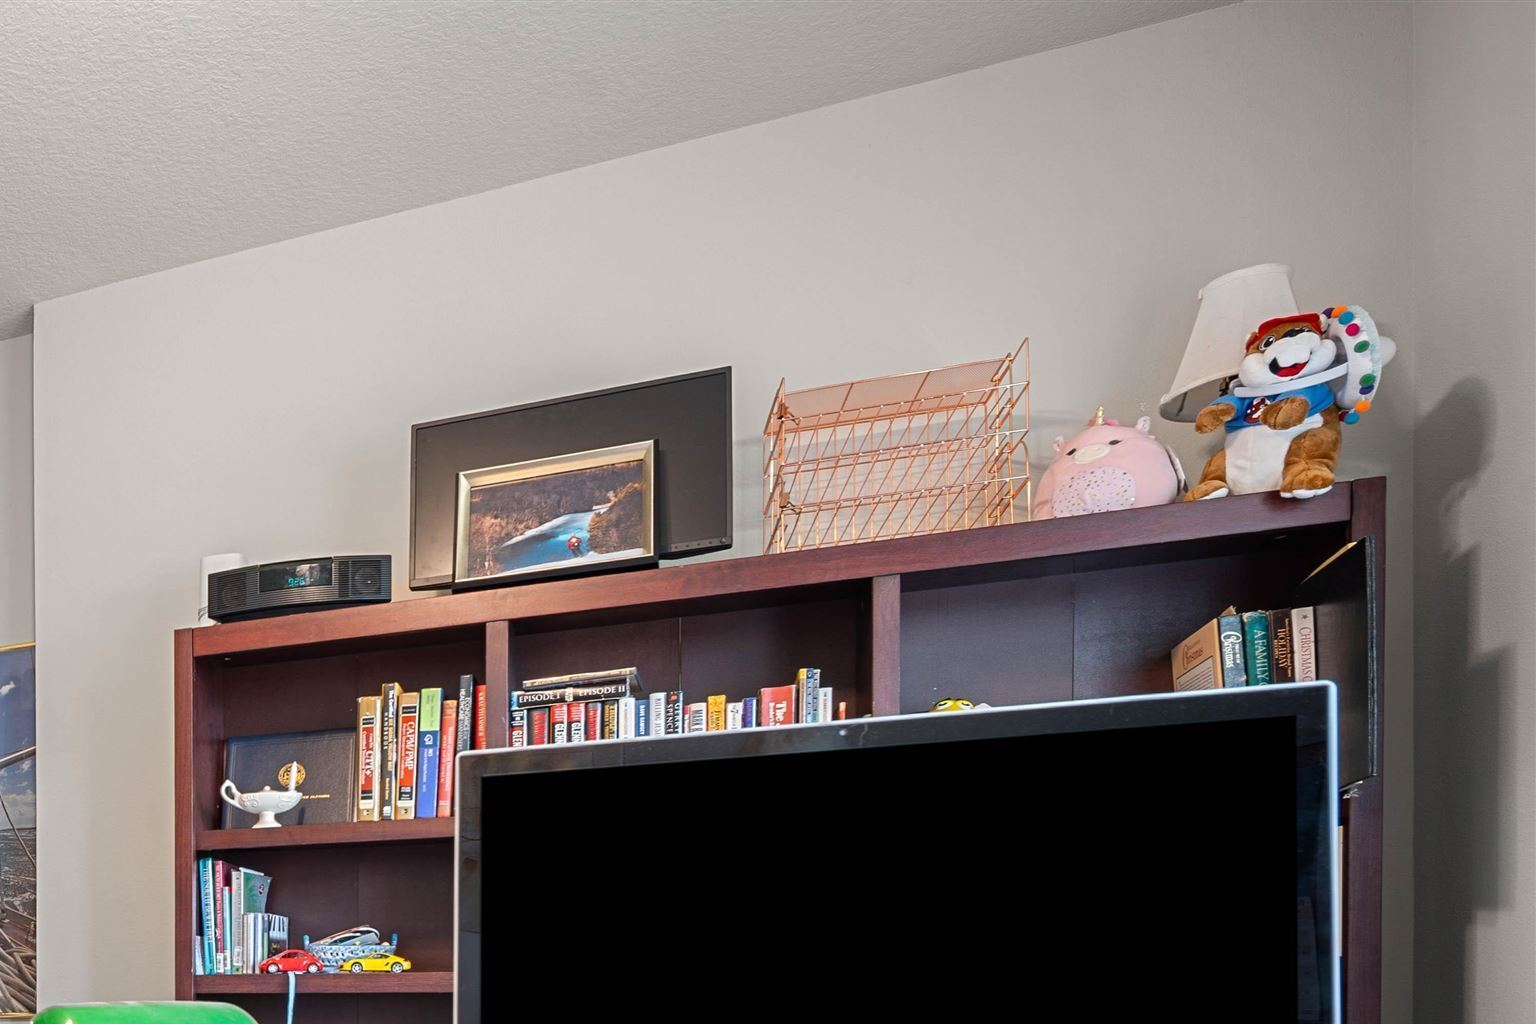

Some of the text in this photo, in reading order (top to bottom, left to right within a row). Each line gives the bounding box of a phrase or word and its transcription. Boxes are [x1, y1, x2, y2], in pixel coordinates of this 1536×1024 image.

[1221, 631, 1243, 669] Christmas
[1254, 639, 1270, 681] FAMILY
[1277, 628, 1288, 669] HOLIDAY
[1298, 626, 1313, 676] CHRISTMAS
[519, 692, 554, 703] EPISODE
[578, 685, 614, 697] EPISODE
[666, 703, 674, 733] SPENCE
[404, 721, 416, 771] CAPM/PMP
